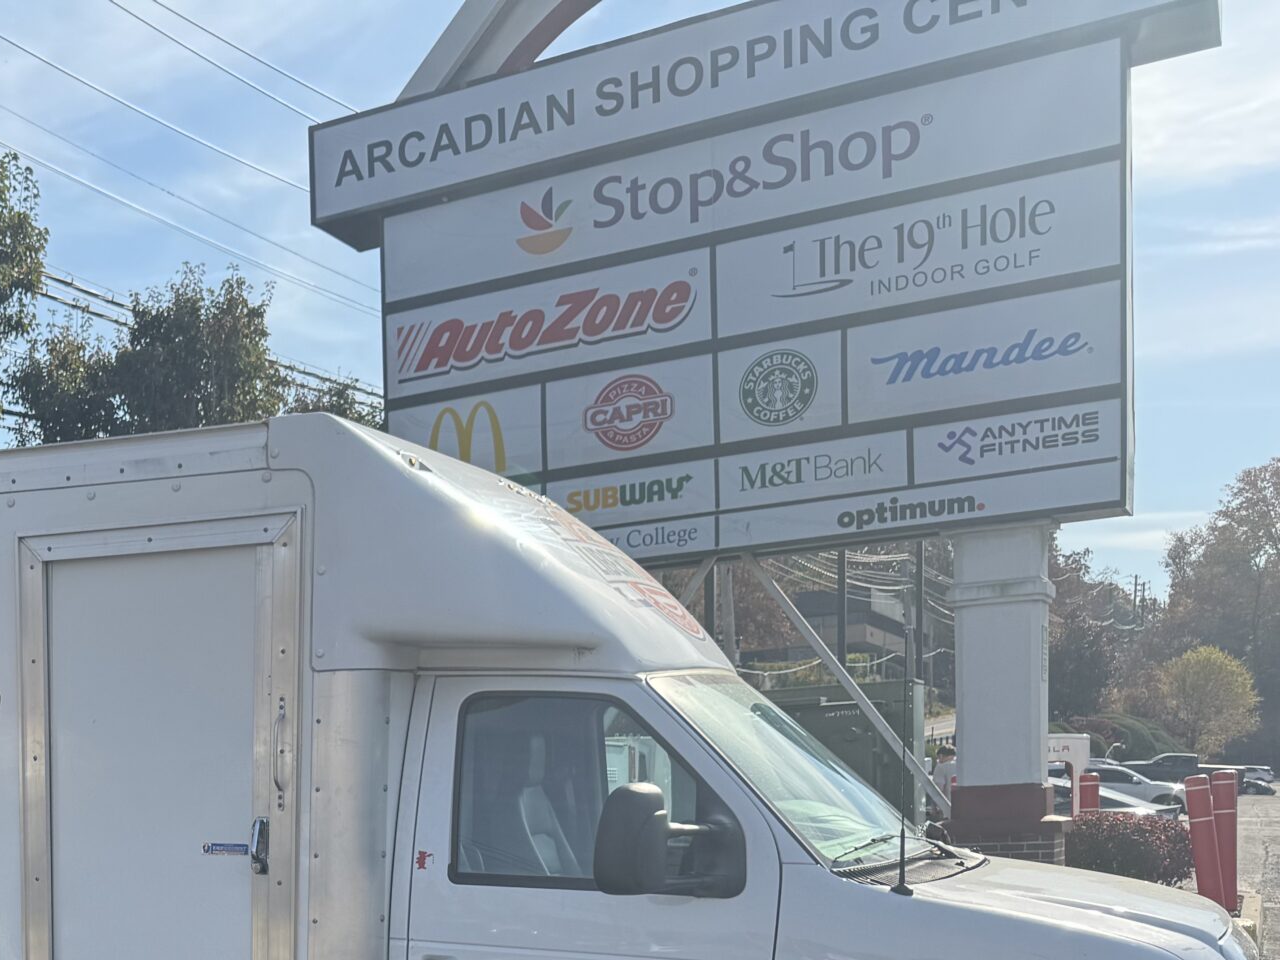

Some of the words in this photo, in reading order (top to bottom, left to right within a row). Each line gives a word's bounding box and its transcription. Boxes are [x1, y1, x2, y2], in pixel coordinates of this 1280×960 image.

[334, 88, 576, 188] ARCADIAN
[594, 7, 880, 118] SHOPPING
[812, 234, 883, 279] The
[961, 195, 1056, 250] Hole
[870, 264, 966, 296] INDOOR
[974, 248, 1042, 276] GOLF
[744, 354, 812, 390] STARBUCKS
[871, 328, 1089, 386] Mandee
[608, 383, 646, 400] PIZZA
[590, 398, 668, 427] CAPRI
[753, 399, 804, 422] COFFEE
[980, 410, 1100, 442] ANYTIME
[615, 427, 650, 444] PASTA
[980, 427, 1100, 459] FITNESS
[738, 456, 810, 492] M&T
[814, 448, 884, 482] Bank
[566, 473, 694, 514] SUBWAY
[626, 526, 698, 548] College
